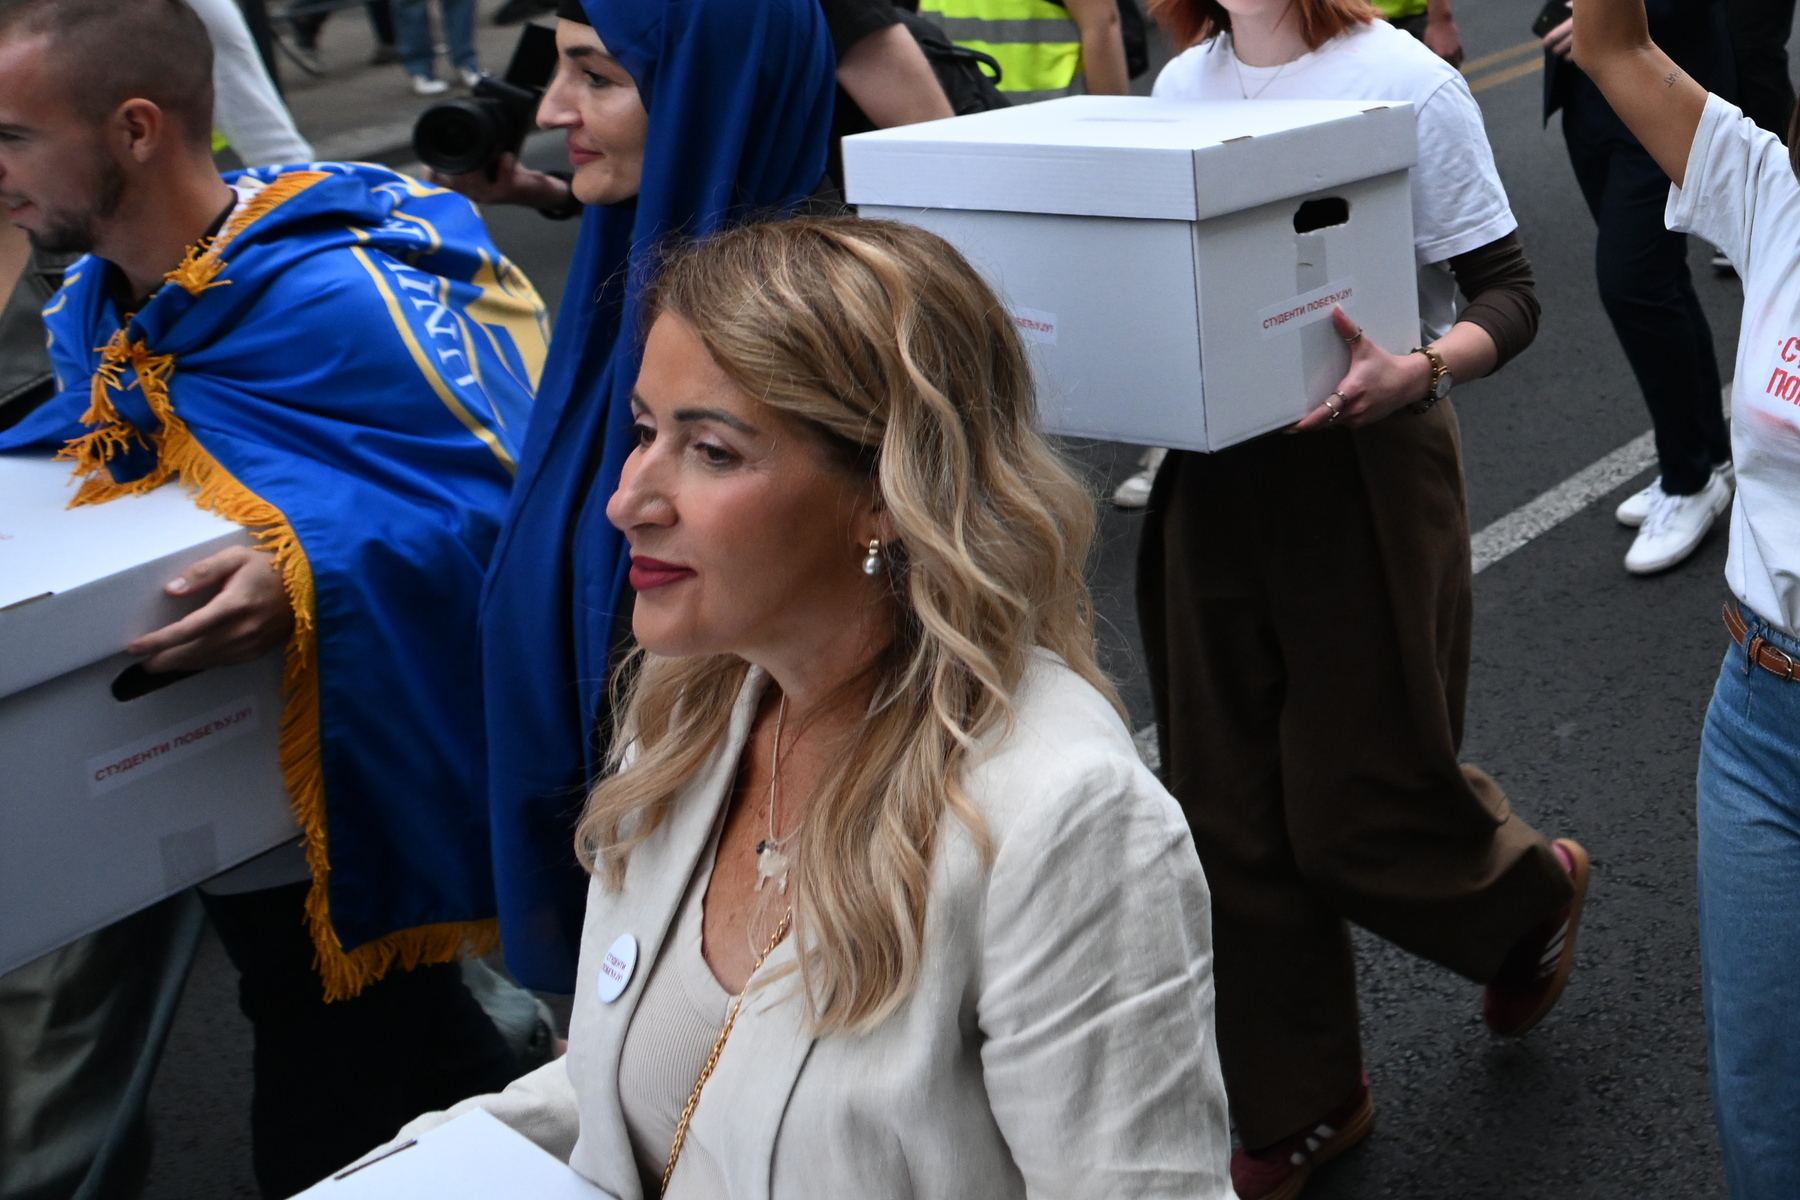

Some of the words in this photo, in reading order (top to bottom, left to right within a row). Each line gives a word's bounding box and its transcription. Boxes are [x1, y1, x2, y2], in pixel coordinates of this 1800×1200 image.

[1262, 305, 1306, 330] СТУДЕНТИ
[1306, 288, 1353, 313] ПОБЕЂУЈУ!
[95, 741, 171, 782] СТУДЕНТИ
